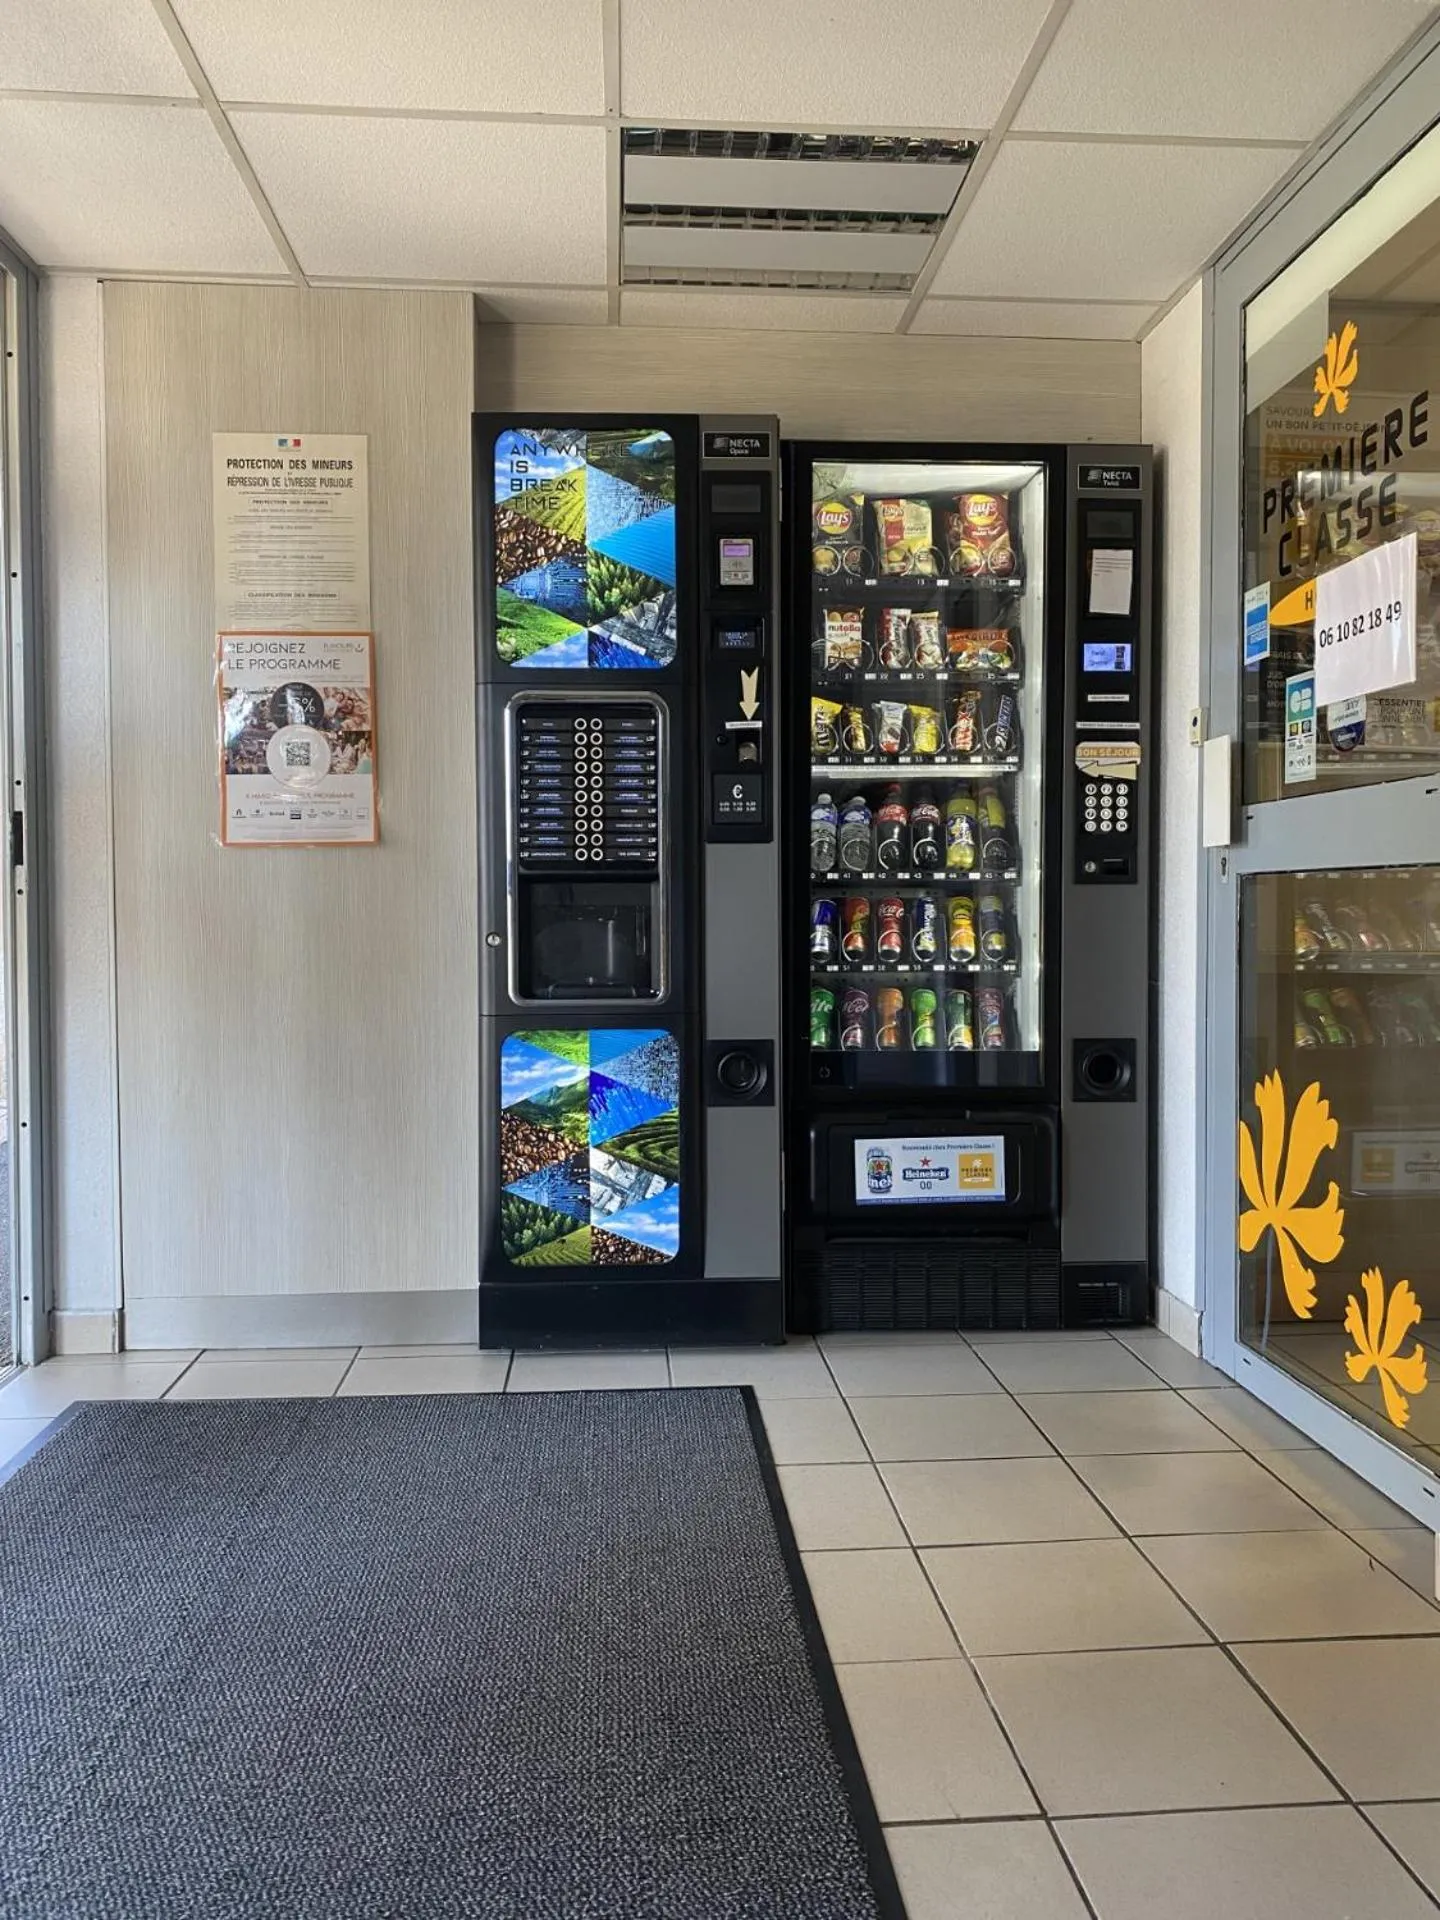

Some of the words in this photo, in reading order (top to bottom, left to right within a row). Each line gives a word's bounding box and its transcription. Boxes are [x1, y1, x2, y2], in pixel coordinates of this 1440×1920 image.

[729, 439, 760, 448] NECTA
[227, 458, 284, 470] PROTECTION
[288, 459, 307, 470] DES
[312, 460, 353, 470] MINEURS
[510, 460, 529, 473] IS
[1102, 471, 1132, 480] NECTA
[272, 477, 281, 488] DE
[320, 478, 354, 488] PUBLIQUE
[510, 478, 578, 492] BREAK
[513, 496, 559, 510] TIME
[827, 624, 861, 633] nutella
[1319, 628, 1334, 648] 06
[1336, 620, 1350, 643] 10
[1352, 614, 1365, 637] 82
[1368, 607, 1382, 631] 18
[1386, 600, 1402, 624] 49
[228, 658, 244, 670] LE
[249, 658, 342, 670] PROGRAMME
[905, 1169, 947, 1179] Heineken
